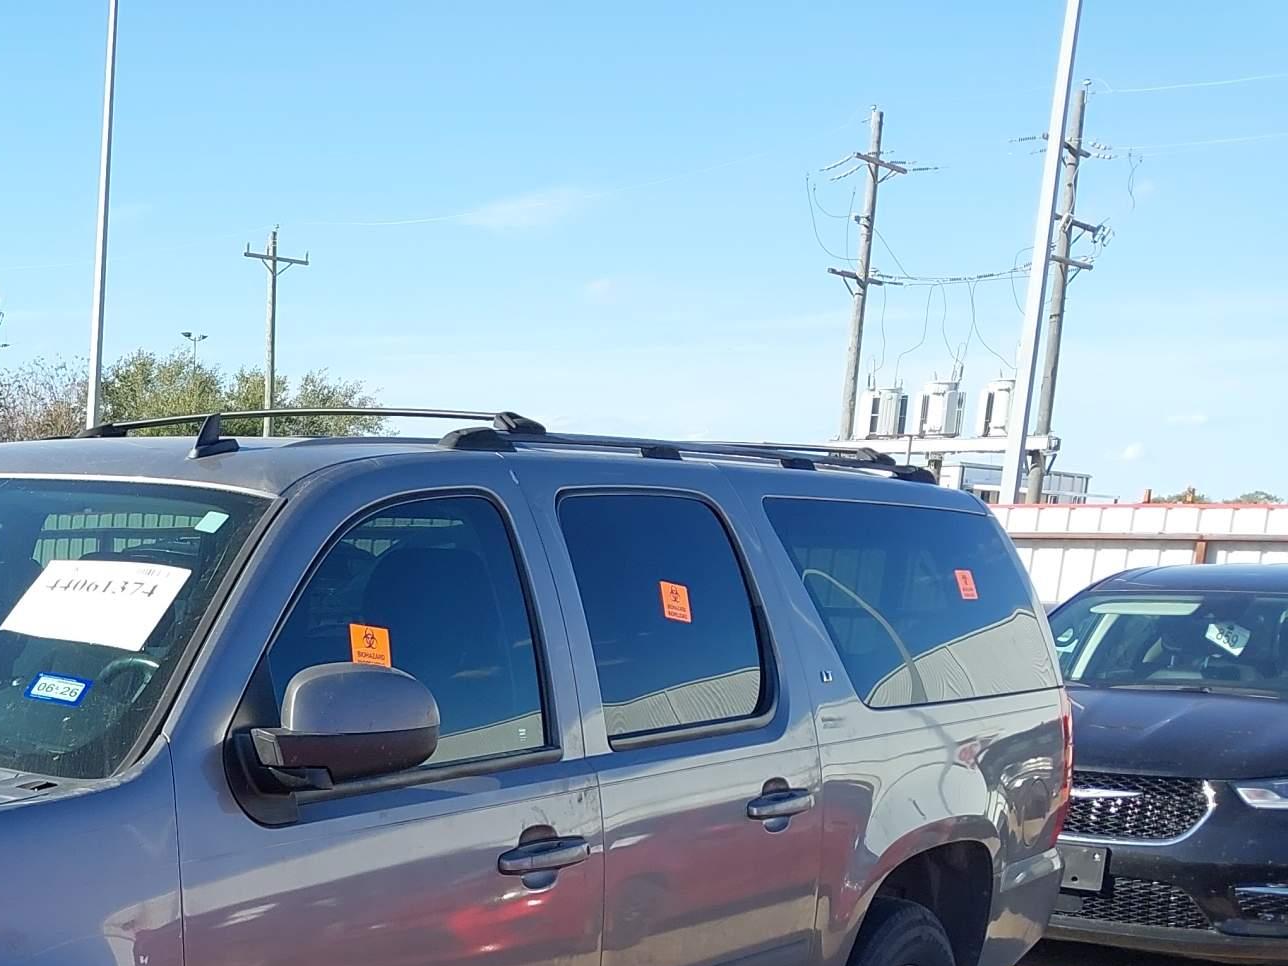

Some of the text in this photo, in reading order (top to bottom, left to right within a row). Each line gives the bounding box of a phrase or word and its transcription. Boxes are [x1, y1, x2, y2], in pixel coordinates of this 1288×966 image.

[45, 578, 159, 598] 44061374
[37, 682, 56, 693] 06
[60, 686, 80, 698] 26
